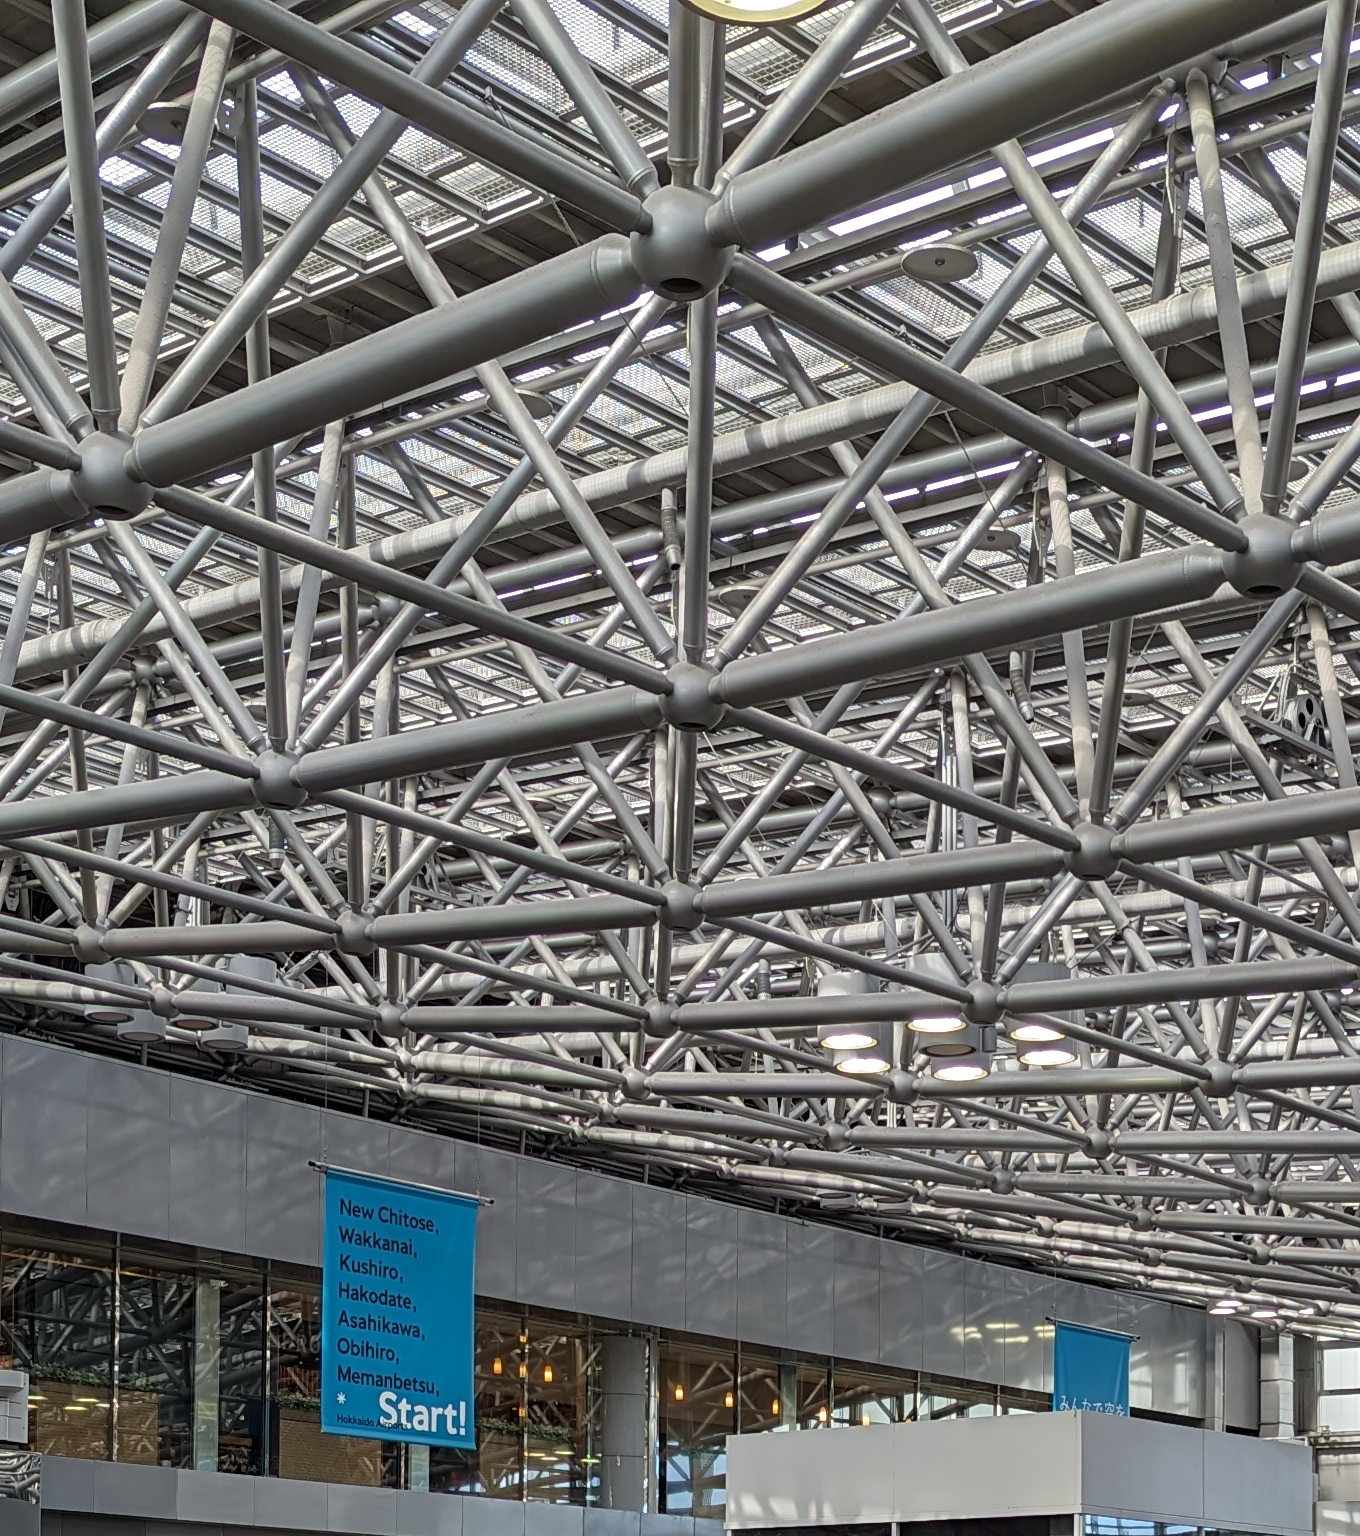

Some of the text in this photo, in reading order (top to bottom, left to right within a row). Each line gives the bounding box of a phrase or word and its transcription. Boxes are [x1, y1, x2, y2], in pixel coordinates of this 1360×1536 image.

[340, 1198, 440, 1235] New Chitose,
[339, 1225, 418, 1259] Wakkanai,
[340, 1254, 404, 1283] Kushiro,
[338, 1281, 418, 1313] Hakodate,
[337, 1310, 426, 1341] Asahikawa,
[337, 1338, 400, 1365] Obihiro,
[337, 1365, 440, 1397] Memanbetsu,
[379, 1391, 467, 1436] Start!
